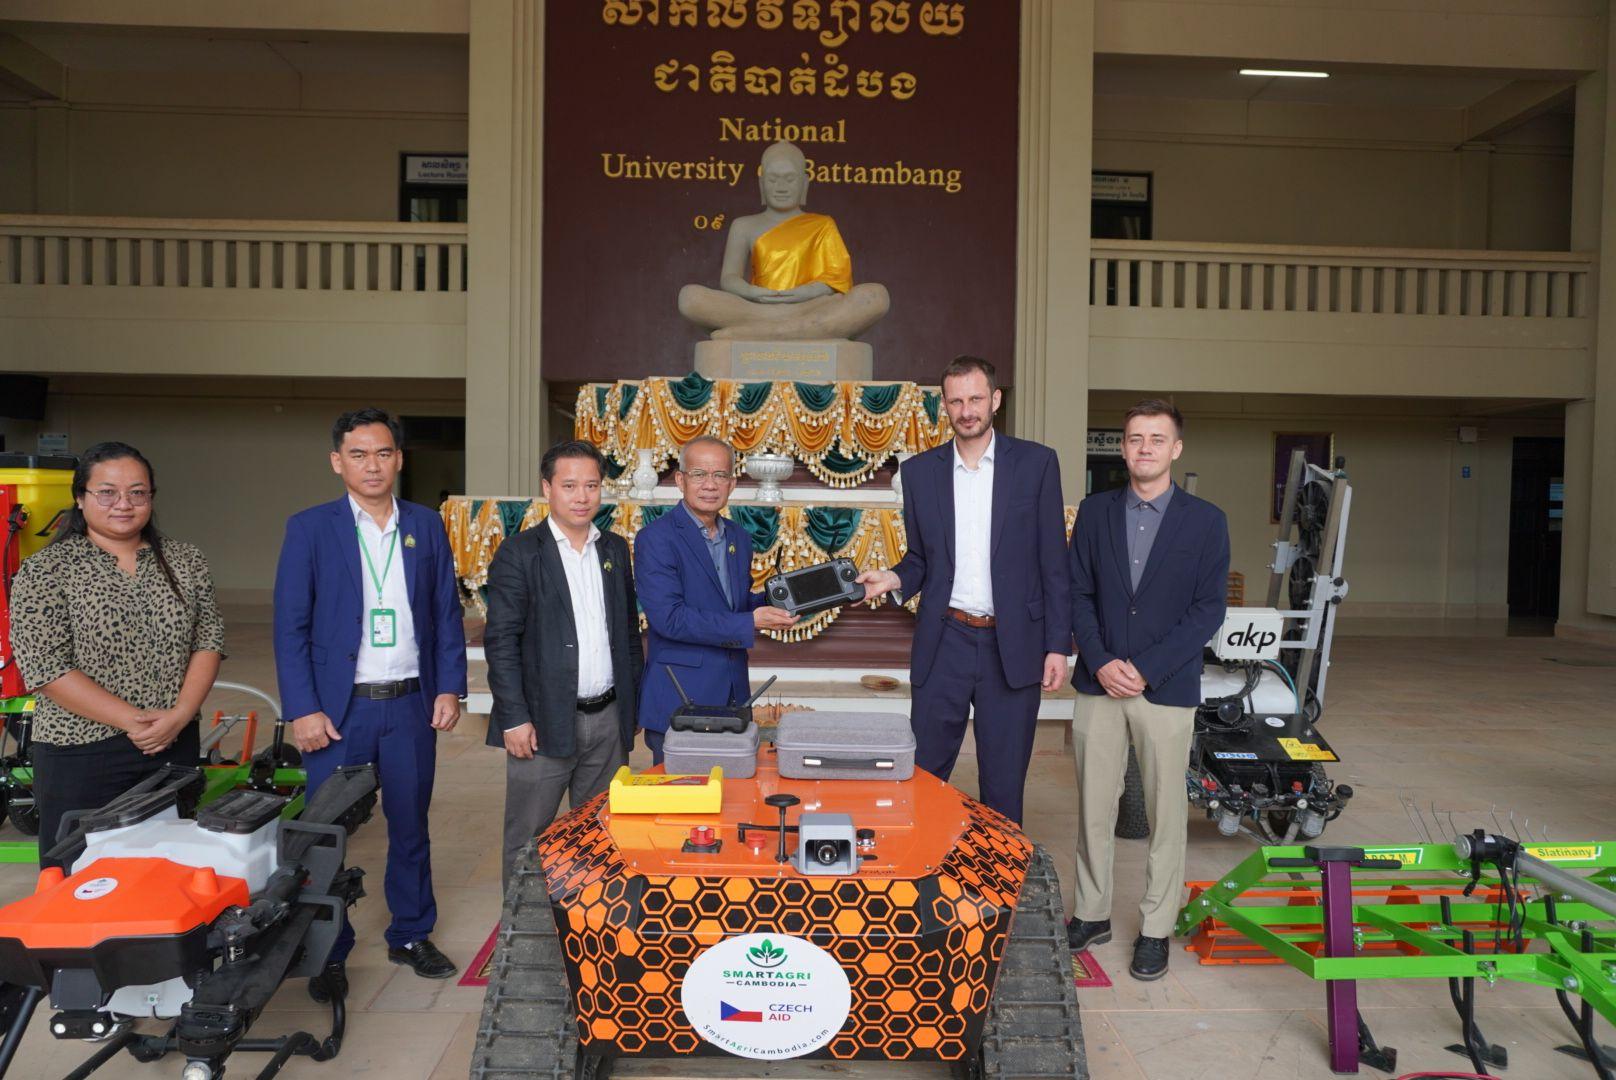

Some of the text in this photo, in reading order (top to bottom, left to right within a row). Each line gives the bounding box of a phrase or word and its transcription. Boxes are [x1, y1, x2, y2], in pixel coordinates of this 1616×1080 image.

[719, 117, 847, 143] National
[601, 152, 962, 194] University Battambang
[1226, 622, 1277, 654] akp
[722, 969, 812, 981] SMARTAGRI
[736, 980, 798, 988] CAMBODIA
[768, 1003, 813, 1013] CZECH
[768, 1013, 792, 1022] AID
[702, 1023, 830, 1056] SmartAgriCambodia.com
